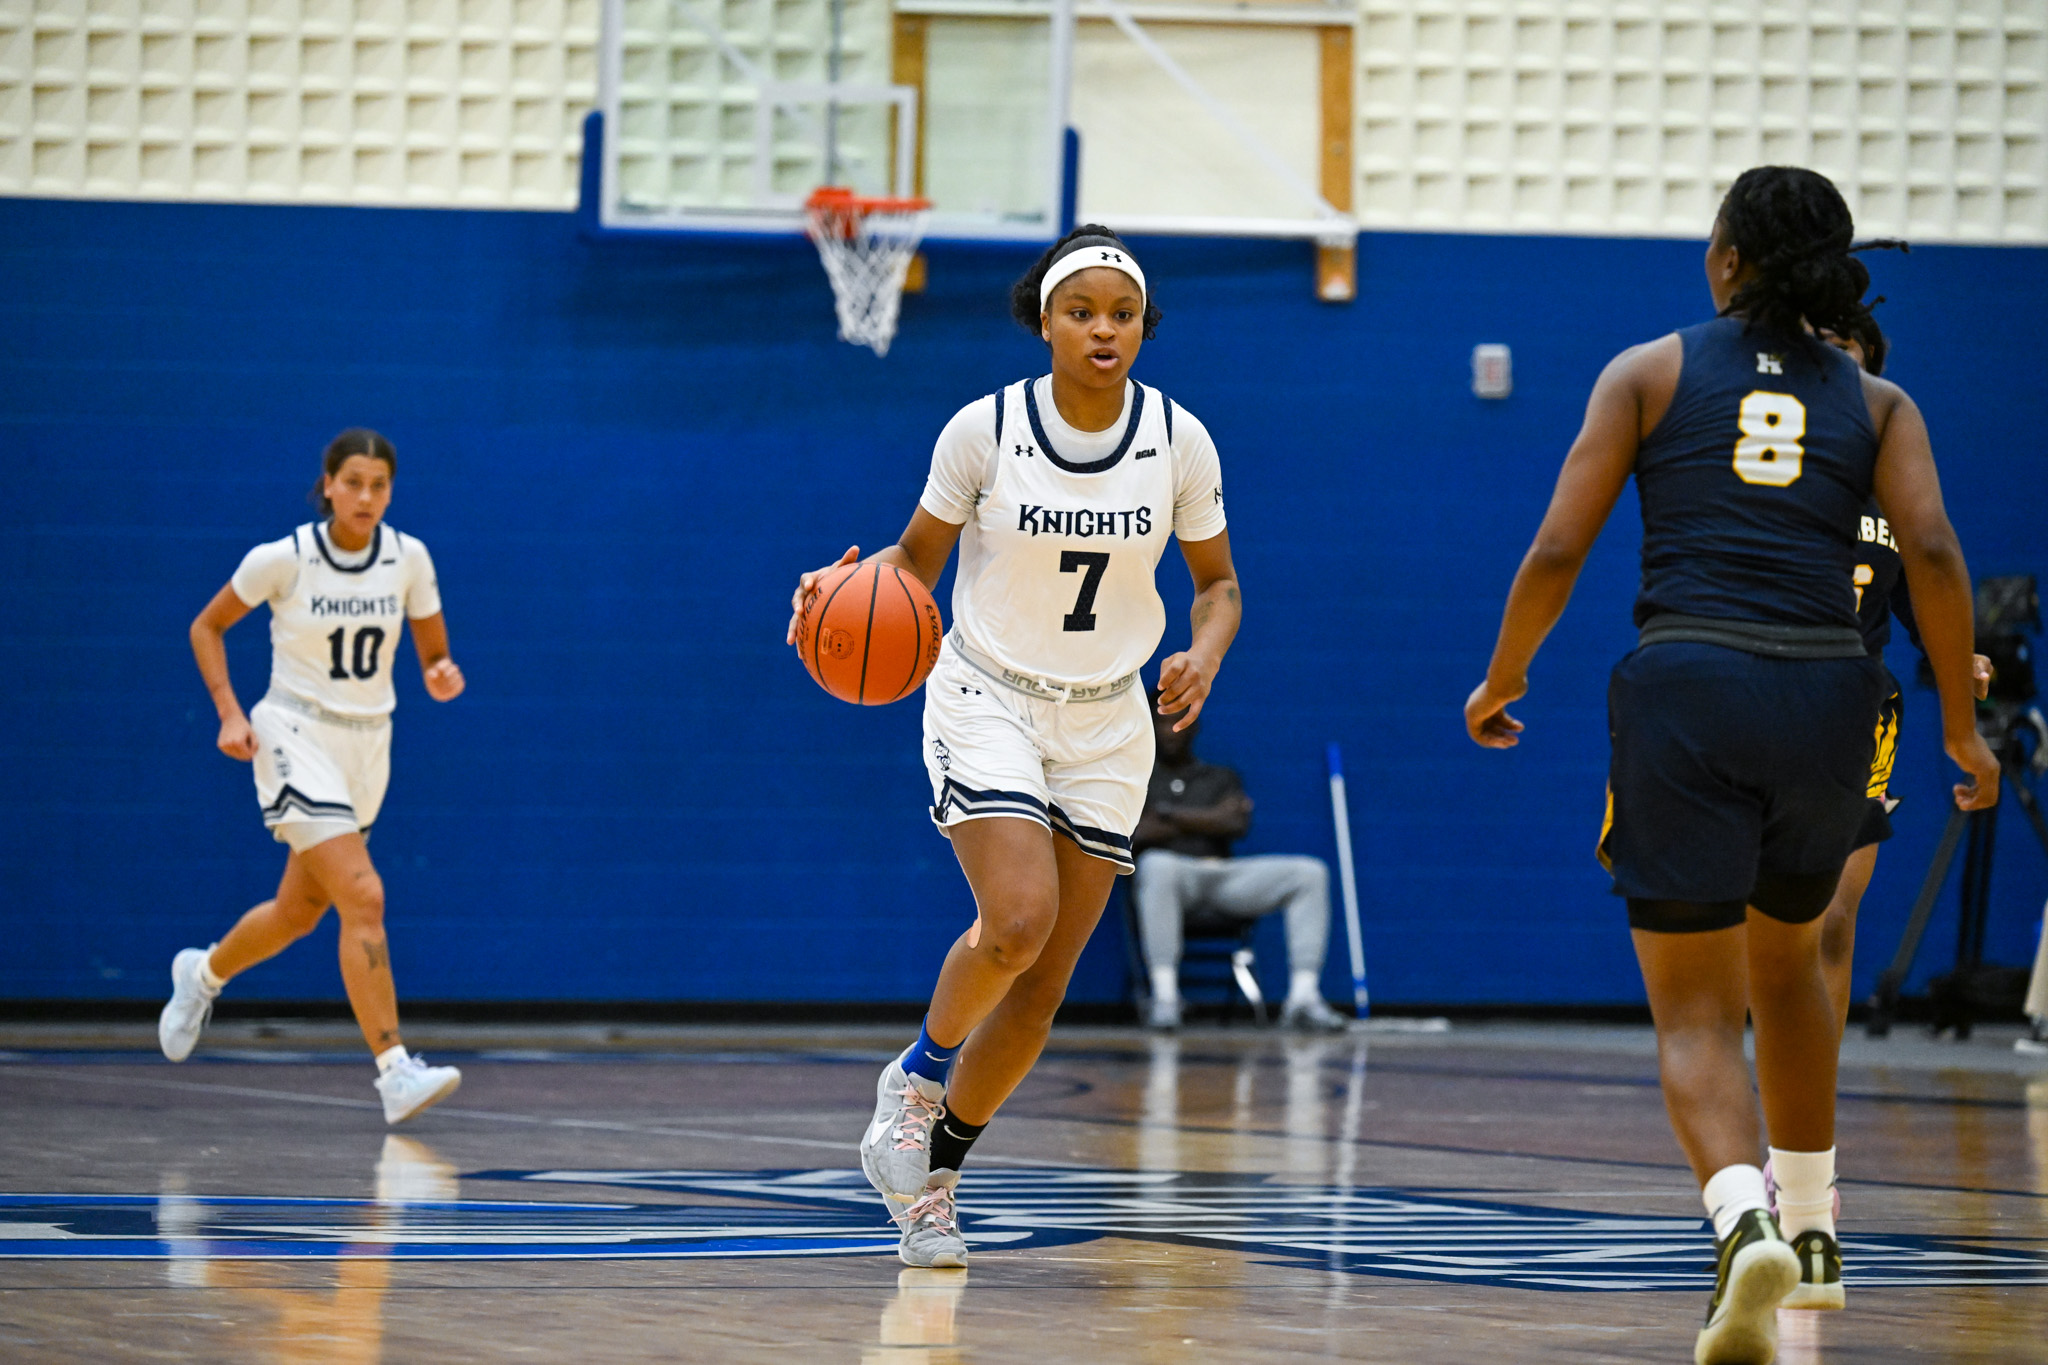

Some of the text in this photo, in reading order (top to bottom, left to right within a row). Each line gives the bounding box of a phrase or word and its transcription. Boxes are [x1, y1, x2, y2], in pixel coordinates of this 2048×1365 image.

[1732, 389, 1807, 488] 8
[1017, 503, 1152, 540] KNIGHTS
[311, 595, 398, 618] KNIGHTS
[1059, 550, 1111, 632] 7
[327, 626, 386, 681] 10
